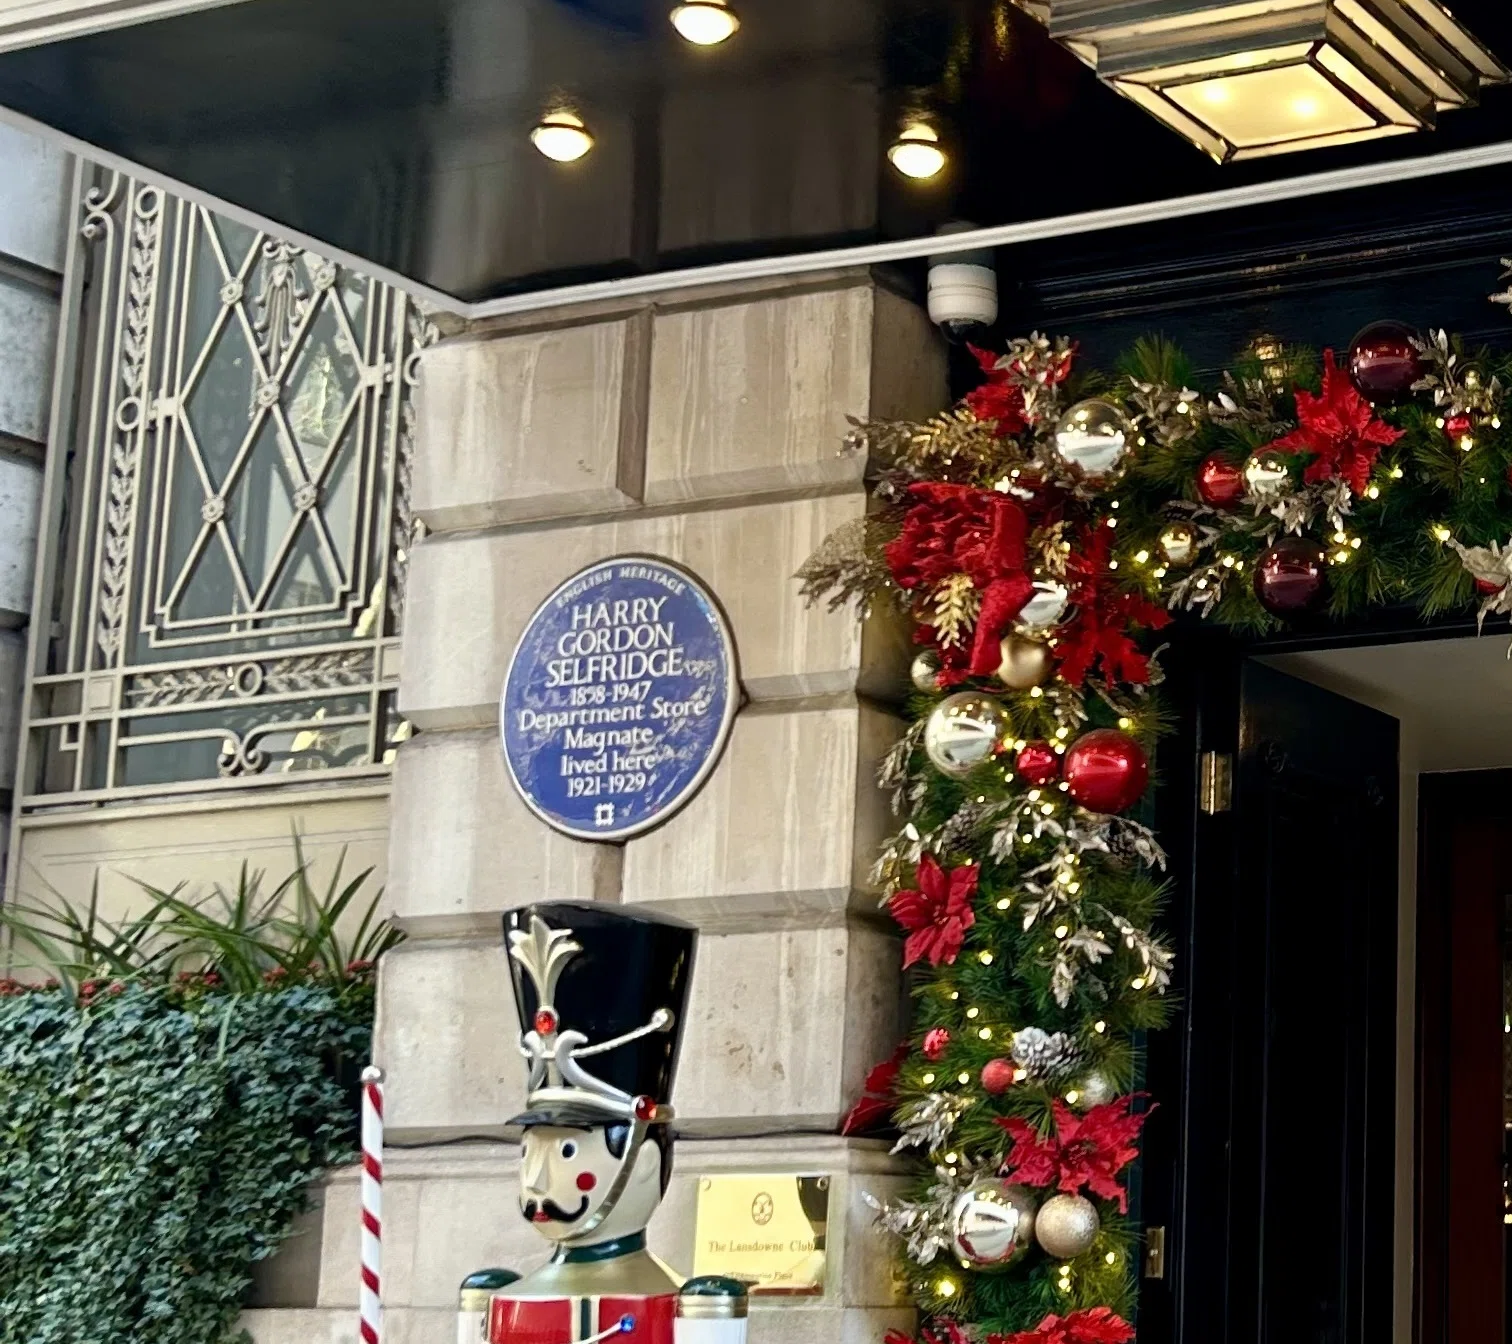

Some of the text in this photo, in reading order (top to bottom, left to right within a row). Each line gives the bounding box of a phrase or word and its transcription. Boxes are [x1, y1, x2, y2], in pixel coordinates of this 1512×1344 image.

[555, 566, 686, 608] ENGLISH HERITAGE
[572, 596, 668, 630] HARRY
[558, 622, 674, 656] GORDON
[546, 647, 684, 688] SELFRIDGE
[520, 697, 706, 732] Department Store
[564, 728, 654, 756] Magnate
[562, 750, 656, 776] lived here
[568, 774, 646, 798] 1921-1929
[708, 1240, 726, 1252] The
[729, 1240, 784, 1252] Lansdowne
